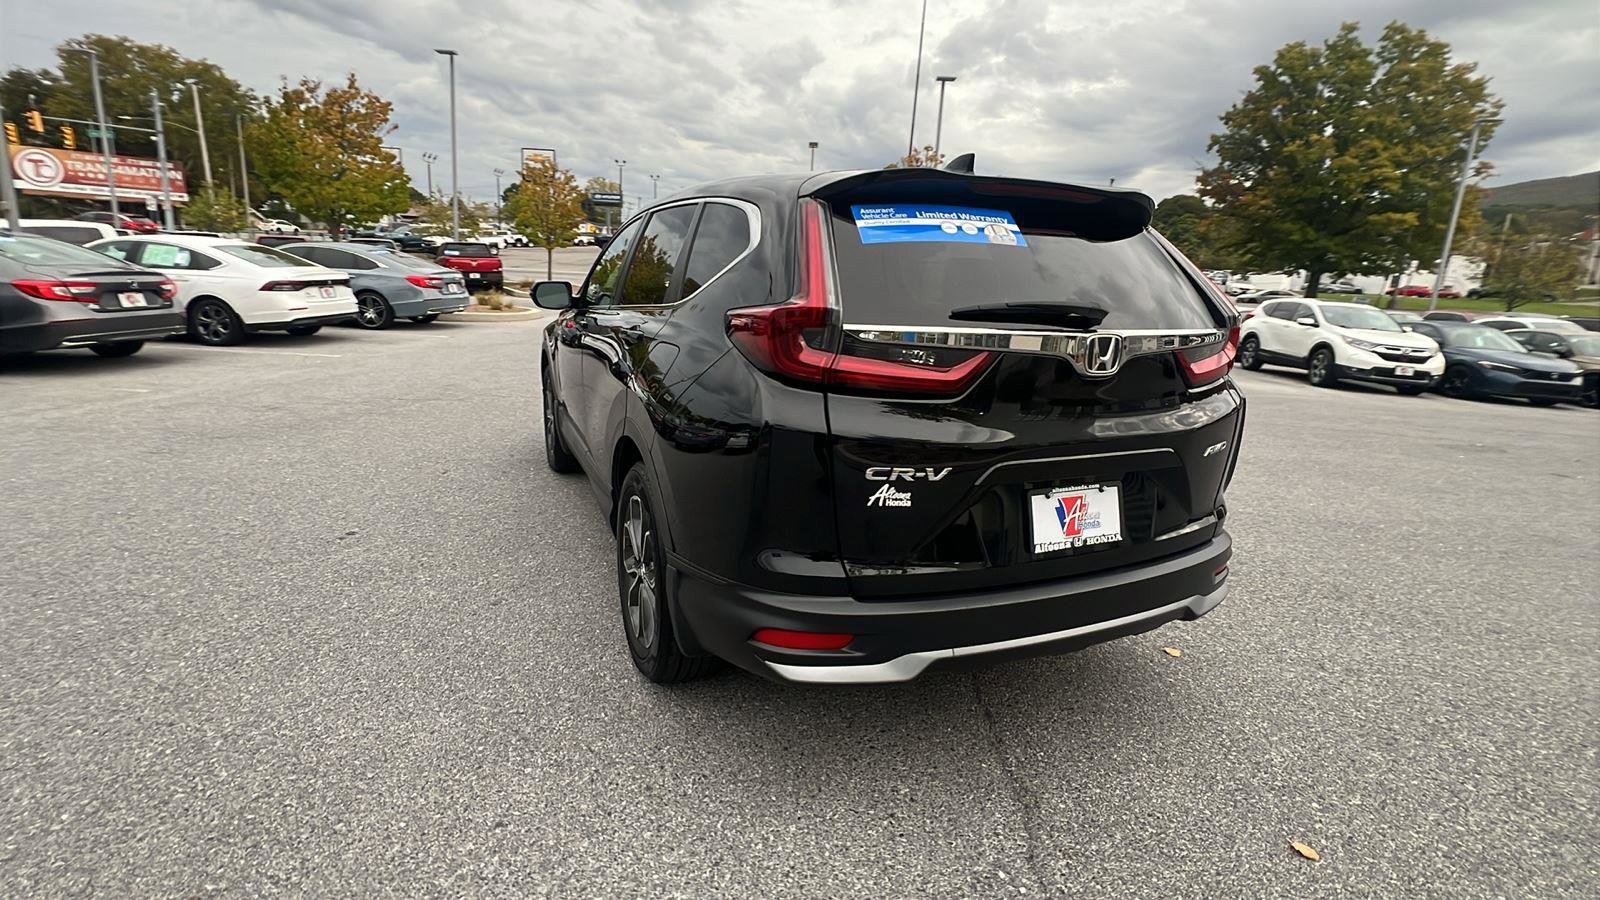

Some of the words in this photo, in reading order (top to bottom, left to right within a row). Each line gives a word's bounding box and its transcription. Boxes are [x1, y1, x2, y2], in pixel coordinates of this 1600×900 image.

[860, 207, 895, 215] Assurant
[916, 211, 958, 220] Limited
[958, 213, 1008, 225] Warranty
[864, 466, 953, 482] CR-V
[885, 499, 912, 507] Honda
[1077, 520, 1101, 531] Honda
[1034, 541, 1072, 554] Altoona
[1086, 533, 1123, 545] HONDA
